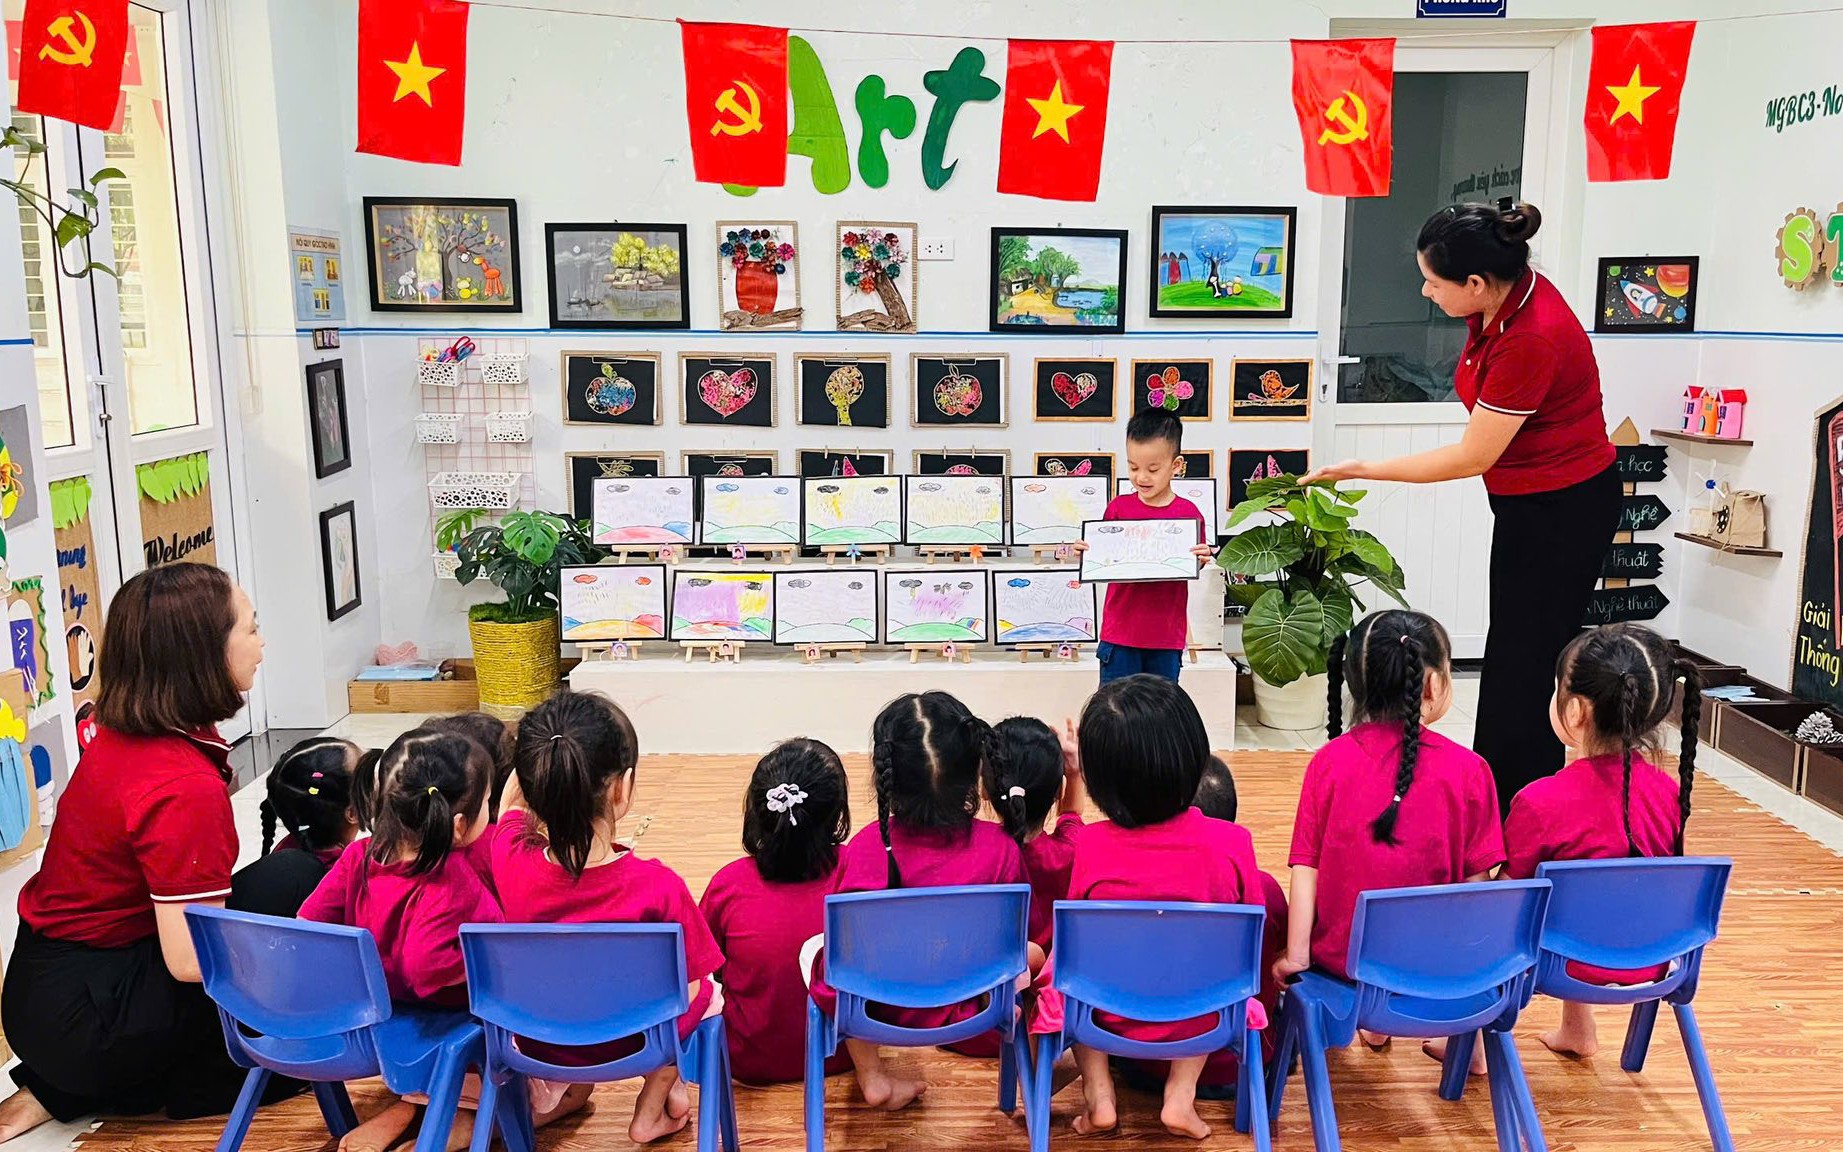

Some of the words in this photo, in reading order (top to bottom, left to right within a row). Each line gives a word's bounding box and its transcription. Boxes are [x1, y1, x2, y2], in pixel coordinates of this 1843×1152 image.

[723, 35, 1001, 197] Art
[1629, 454, 1653, 474] học
[1626, 504, 1659, 529] Nghệ
[143, 526, 214, 569] Welcome
[1612, 549, 1649, 568] thuật
[1803, 600, 1831, 631] Giải
[1800, 635, 1840, 687] Thống
